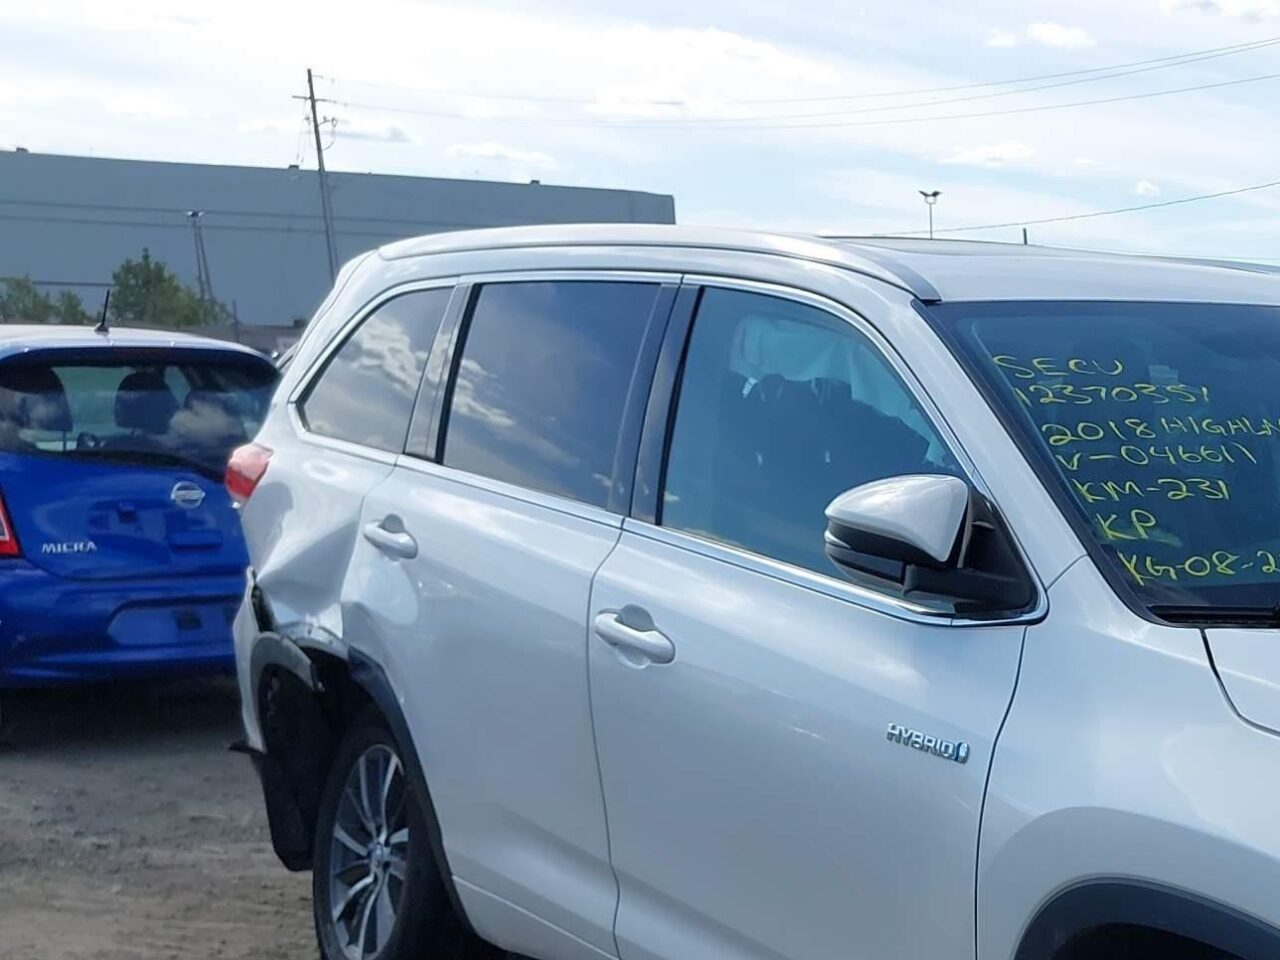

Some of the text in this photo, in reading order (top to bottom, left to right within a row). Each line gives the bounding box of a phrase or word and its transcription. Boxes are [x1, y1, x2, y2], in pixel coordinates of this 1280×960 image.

[993, 355, 1122, 379] SECU
[1015, 383, 1208, 407] 12370351
[1042, 418, 1155, 445] 2018
[1073, 478, 1230, 503] KM-231
[1097, 509, 1157, 540] KP
[42, 541, 96, 553] MICRA
[887, 722, 956, 760] HYBRID
